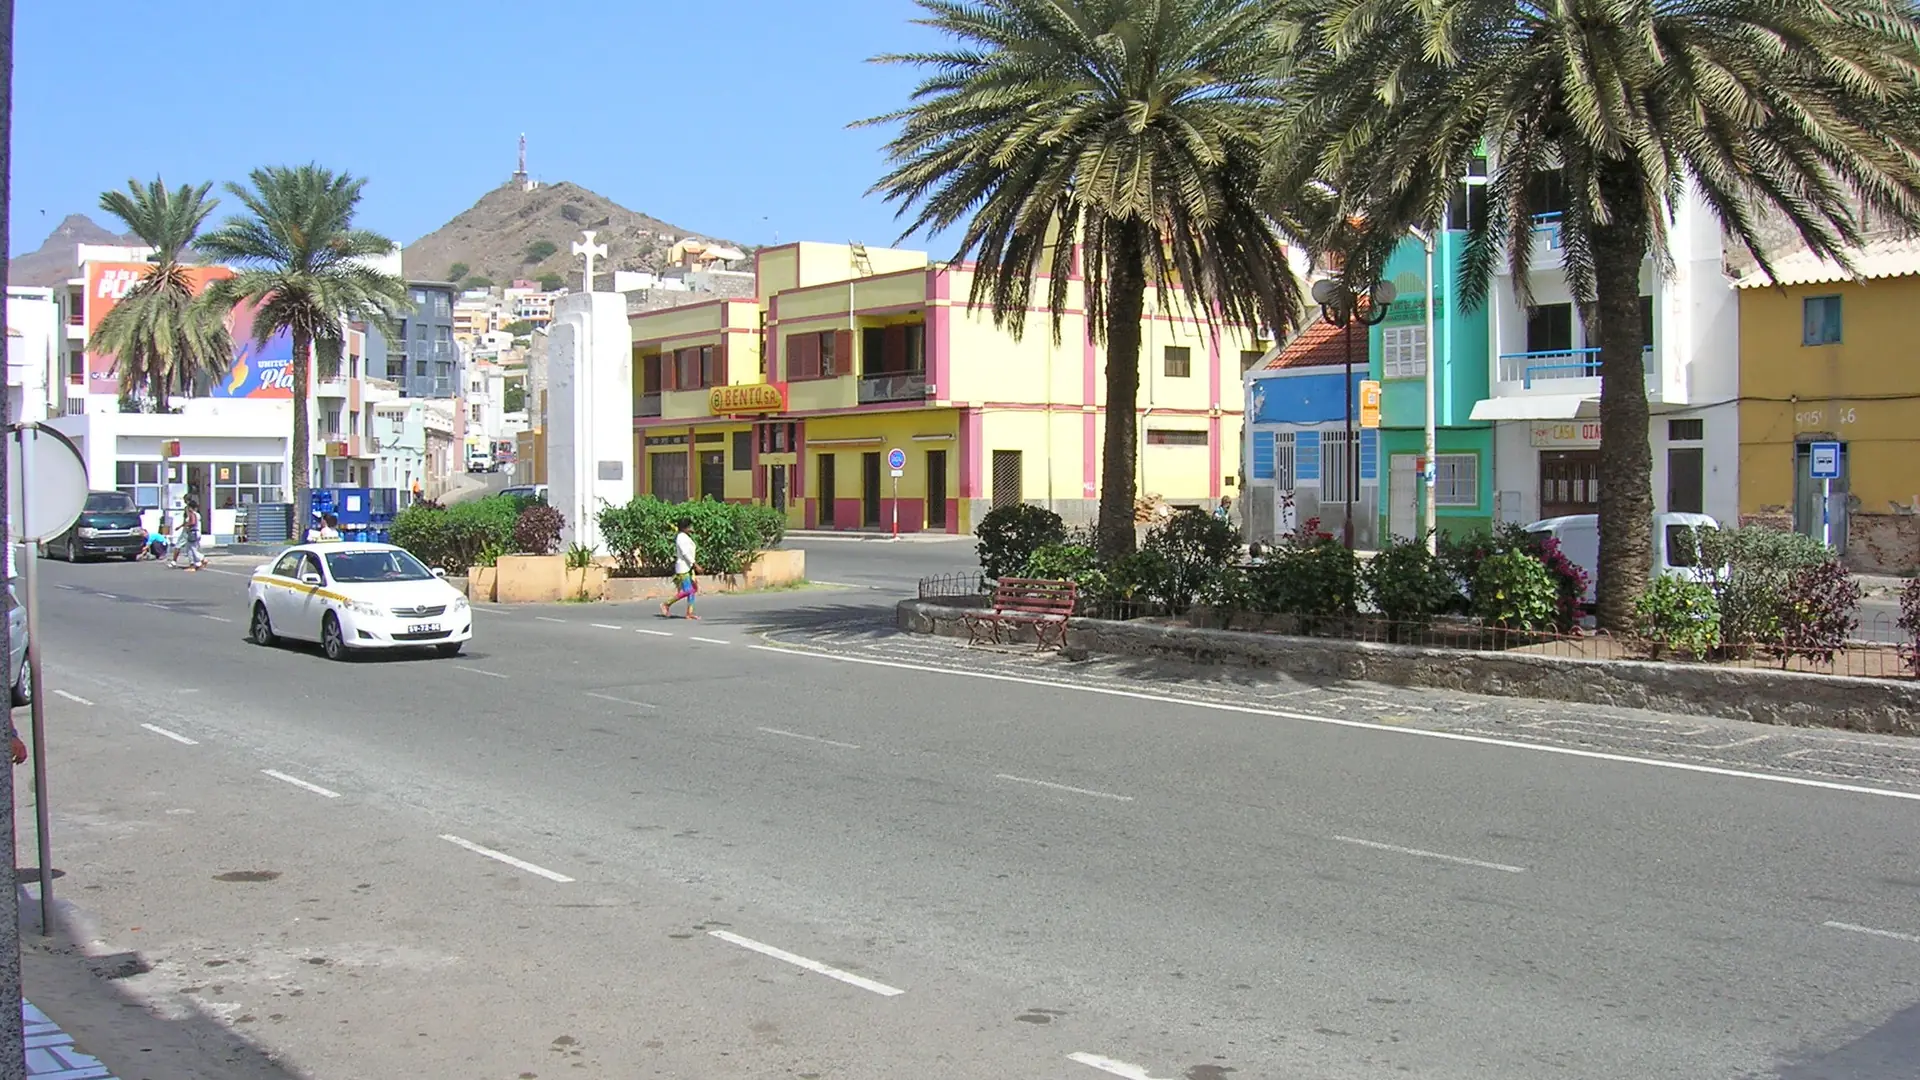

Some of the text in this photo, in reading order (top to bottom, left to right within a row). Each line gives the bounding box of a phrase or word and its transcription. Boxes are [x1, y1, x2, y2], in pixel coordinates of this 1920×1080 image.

[260, 367, 294, 392] Pla
[1553, 424, 1602, 440] CASA QIA
